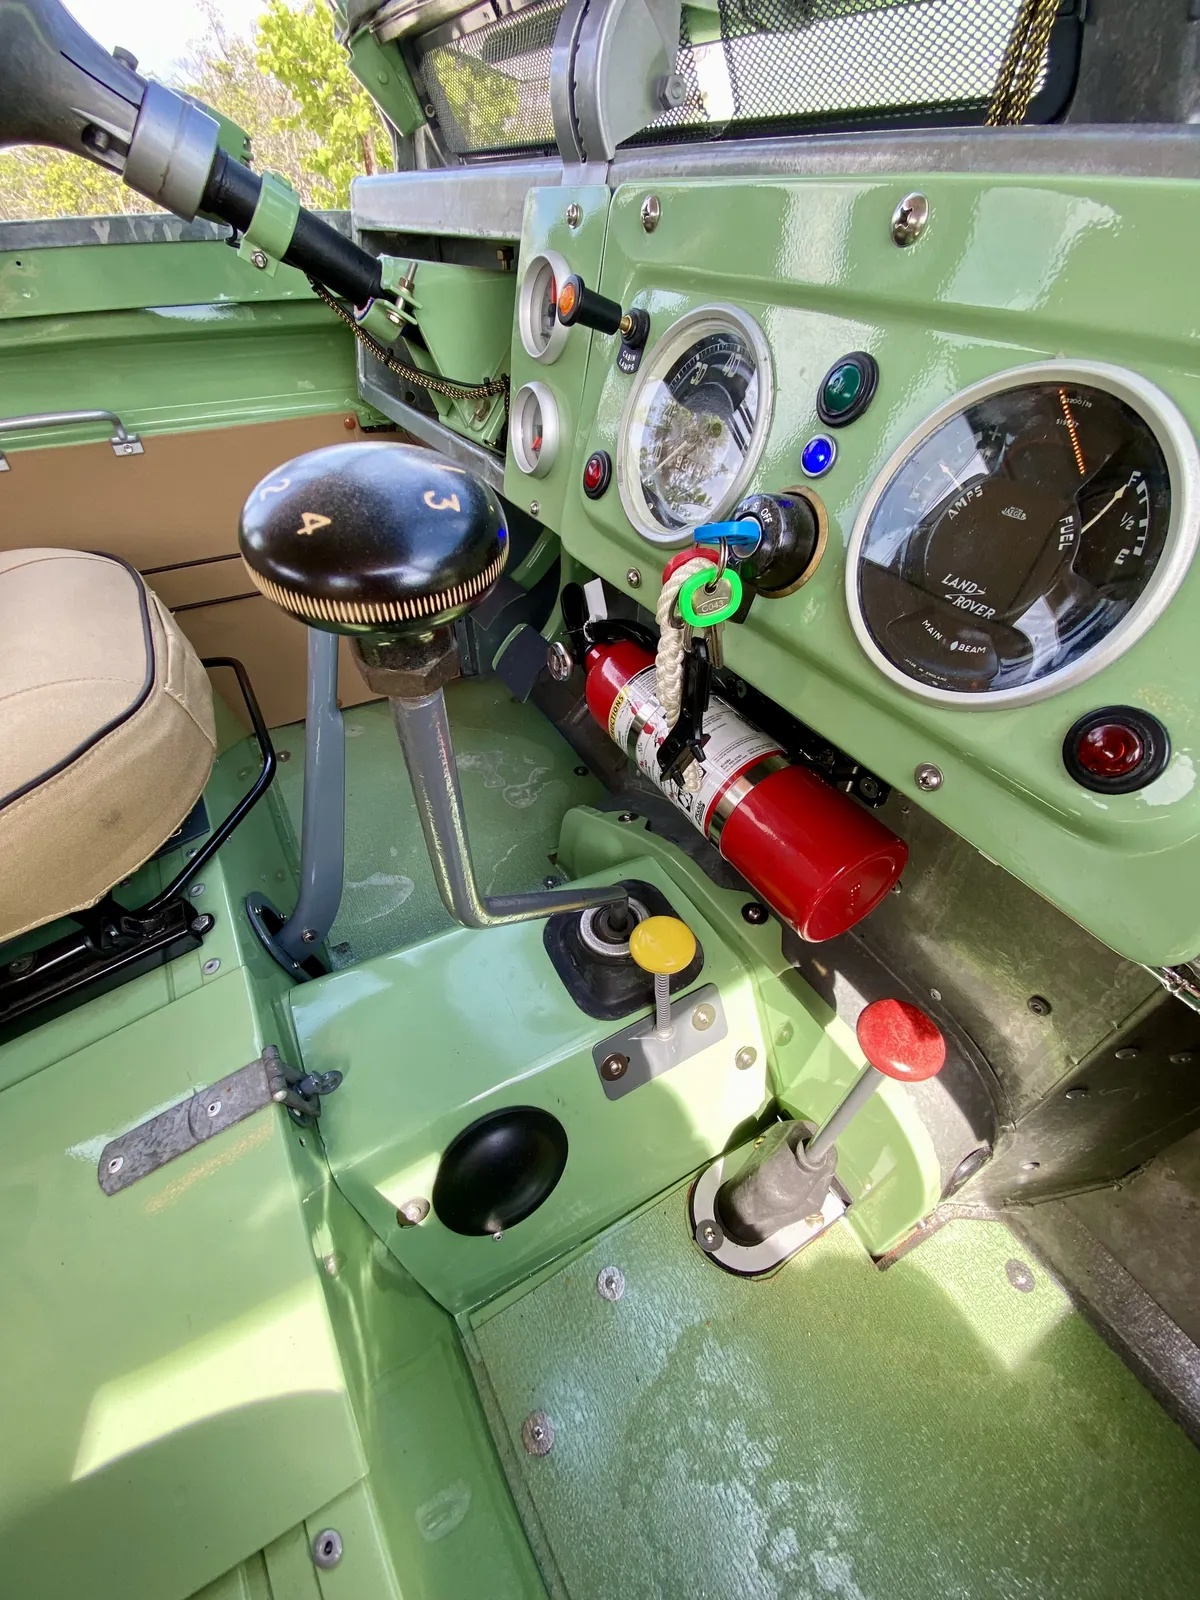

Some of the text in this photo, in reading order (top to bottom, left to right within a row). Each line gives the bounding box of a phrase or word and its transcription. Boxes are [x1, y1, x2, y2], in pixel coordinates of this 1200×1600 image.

[690, 361, 709, 386] 30
[721, 352, 742, 378] 40
[259, 477, 290, 502] 2
[1127, 470, 1142, 487] F
[424, 490, 461, 513] 3
[751, 501, 760, 511] S
[947, 485, 983, 520] AMPS
[296, 511, 332, 536] 4
[760, 507, 773, 524] OFF
[1120, 511, 1135, 531] 1/2
[1058, 515, 1074, 551] FUEL
[1114, 548, 1130, 565] E
[941, 573, 978, 595] LAND
[951, 595, 996, 620] ROVER
[921, 619, 987, 654] MAIN BEAM
